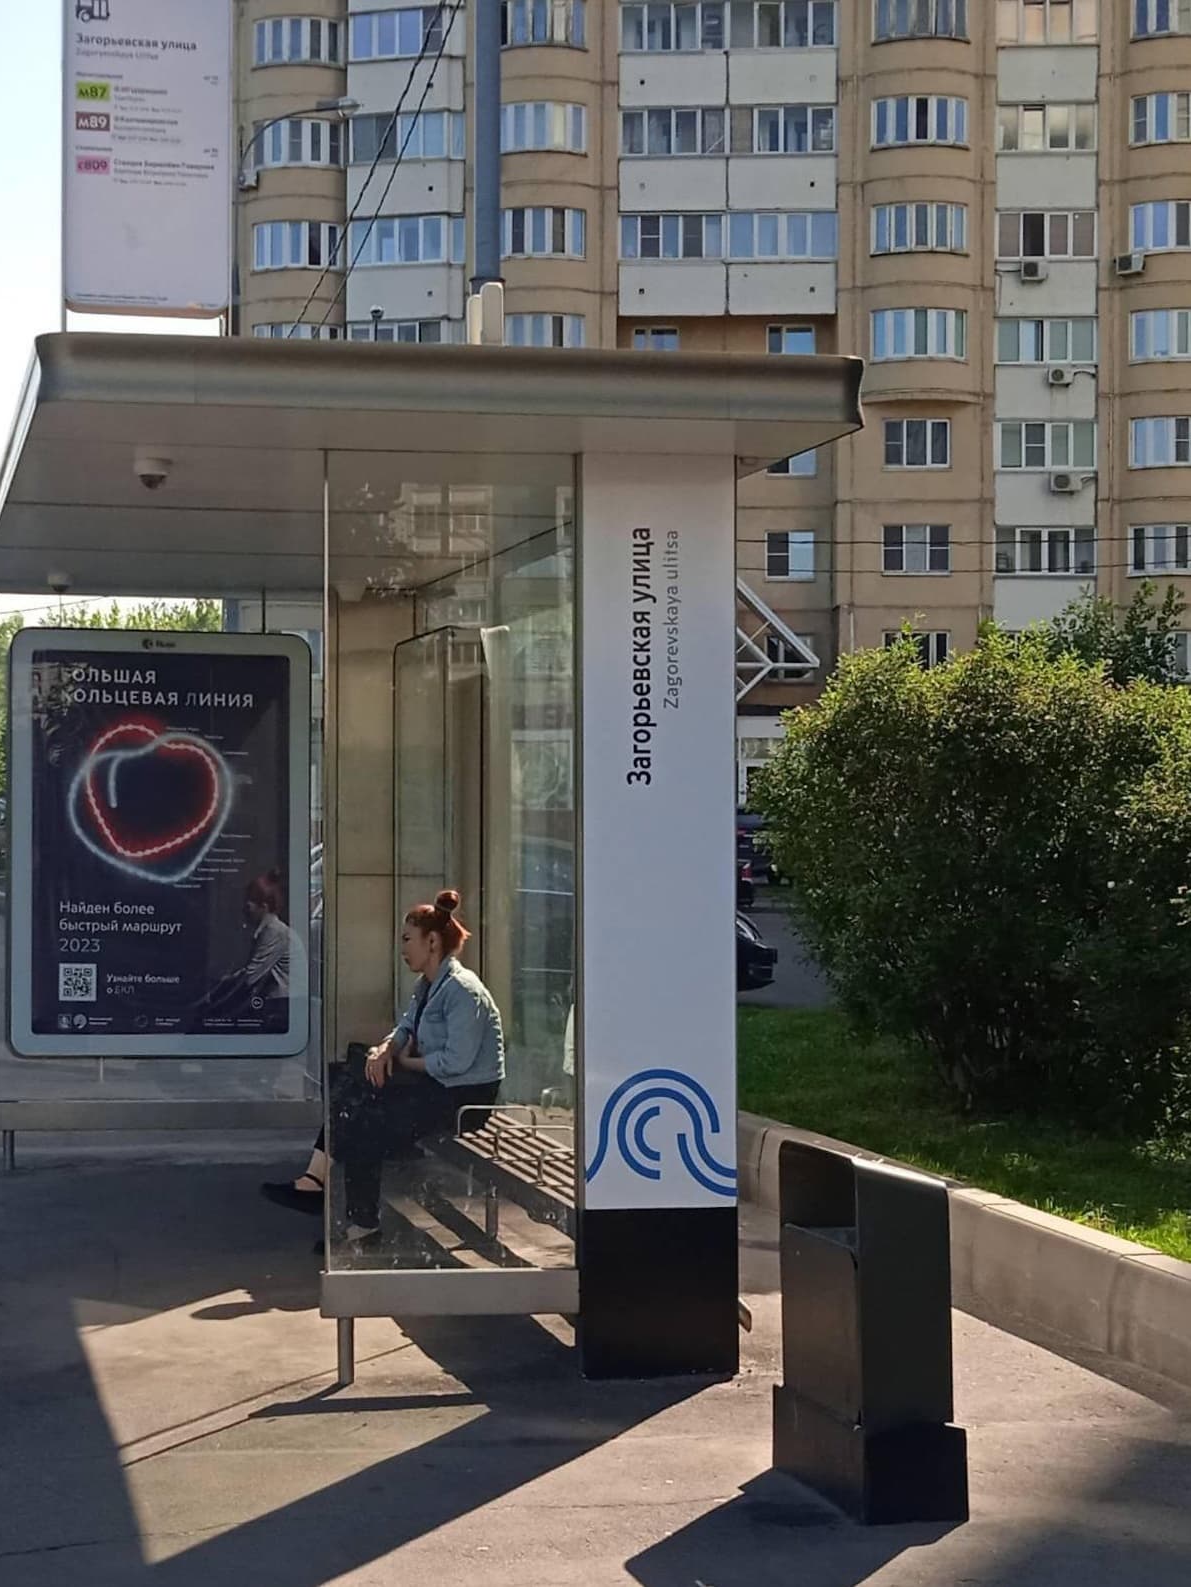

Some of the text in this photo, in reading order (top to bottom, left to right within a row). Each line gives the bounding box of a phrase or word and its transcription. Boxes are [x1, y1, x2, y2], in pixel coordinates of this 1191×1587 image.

[75, 32, 198, 51] Загорьевская улица
[662, 530, 682, 709] Zagorevskaya ulitsa
[626, 527, 657, 786] Загорьевская улица
[61, 667, 156, 684] ОЛЬШАЯ
[185, 692, 254, 708] ЛИНИЯ
[59, 901, 155, 915] Найден более
[59, 918, 182, 935] быстрый маршрут
[59, 938, 101, 953] 2023
[106, 973, 180, 984] Узнайте больше
